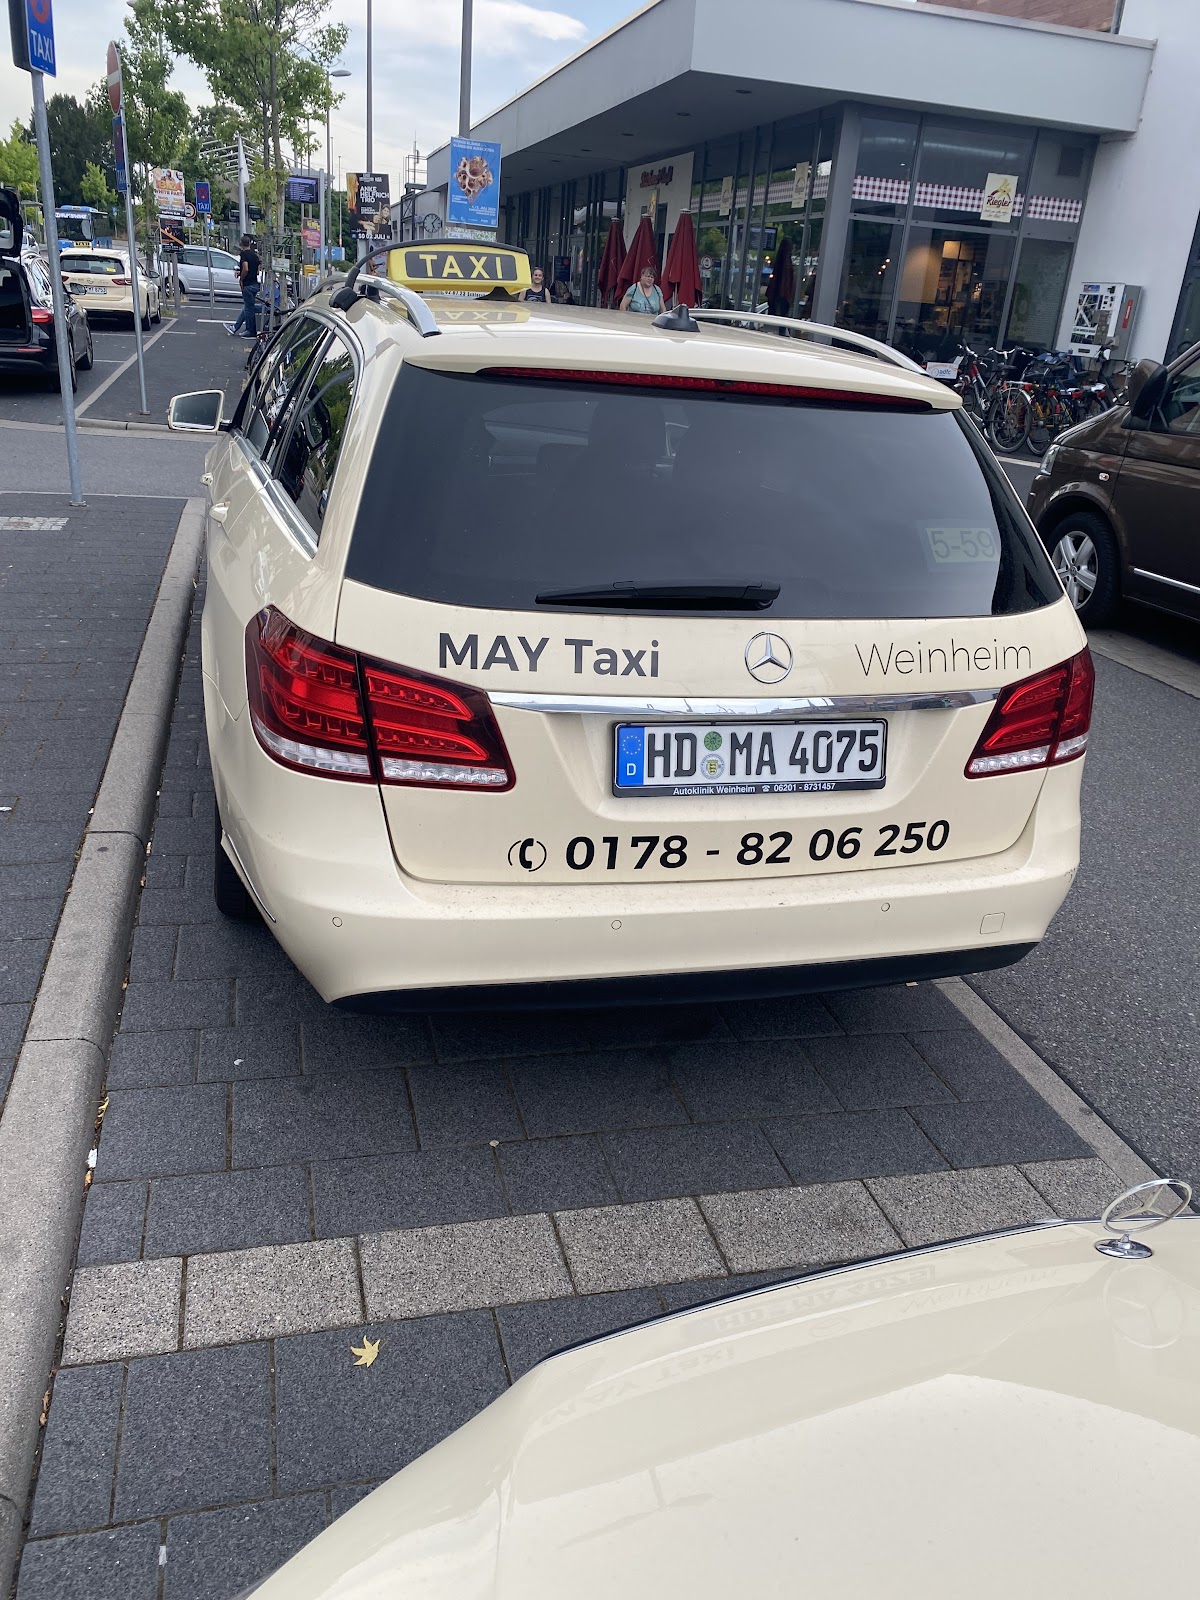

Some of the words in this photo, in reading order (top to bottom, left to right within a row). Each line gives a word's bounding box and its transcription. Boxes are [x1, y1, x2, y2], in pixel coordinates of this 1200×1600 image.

[30, 28, 54, 64] TAXI
[197, 202, 210, 210] TAXI
[360, 190, 390, 198] HELFRICH
[986, 195, 1012, 208] Riegler
[419, 253, 503, 279] TAXI
[930, 530, 996, 559] 5-59
[438, 632, 550, 673] MAY
[565, 638, 659, 678] Taxi
[854, 638, 1032, 677] Weinheim
[626, 763, 637, 776] D
[647, 732, 698, 778] HD
[729, 731, 777, 776] MA
[789, 729, 879, 774] 4075
[673, 786, 714, 796] Autoklinik
[716, 785, 756, 795] Weinheim
[773, 784, 796, 792] 06201
[804, 783, 836, 791] 8731457
[565, 835, 688, 871] 0178
[736, 831, 793, 866] 82
[808, 826, 863, 862] 06
[874, 819, 950, 857] 250
